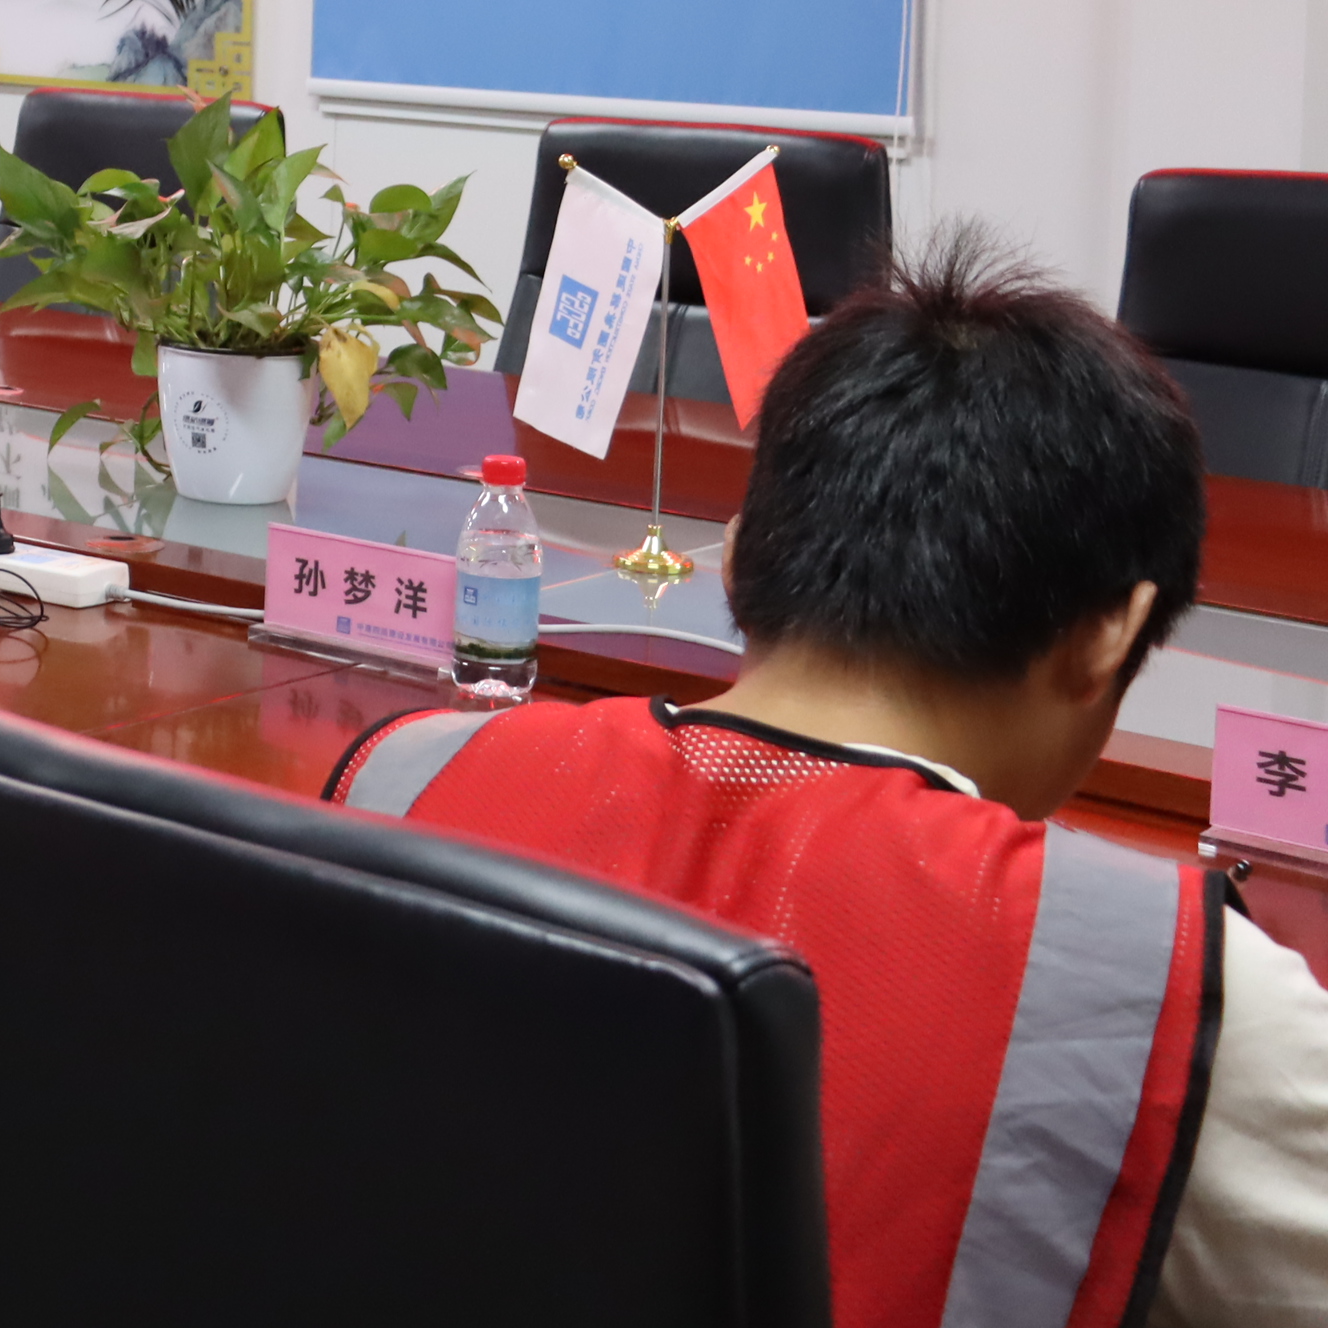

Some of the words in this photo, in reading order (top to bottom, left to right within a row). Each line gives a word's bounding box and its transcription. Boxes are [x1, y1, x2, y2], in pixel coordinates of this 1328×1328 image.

[294, 558, 428, 619] 孙梦洋
[1256, 750, 1307, 798] 李
